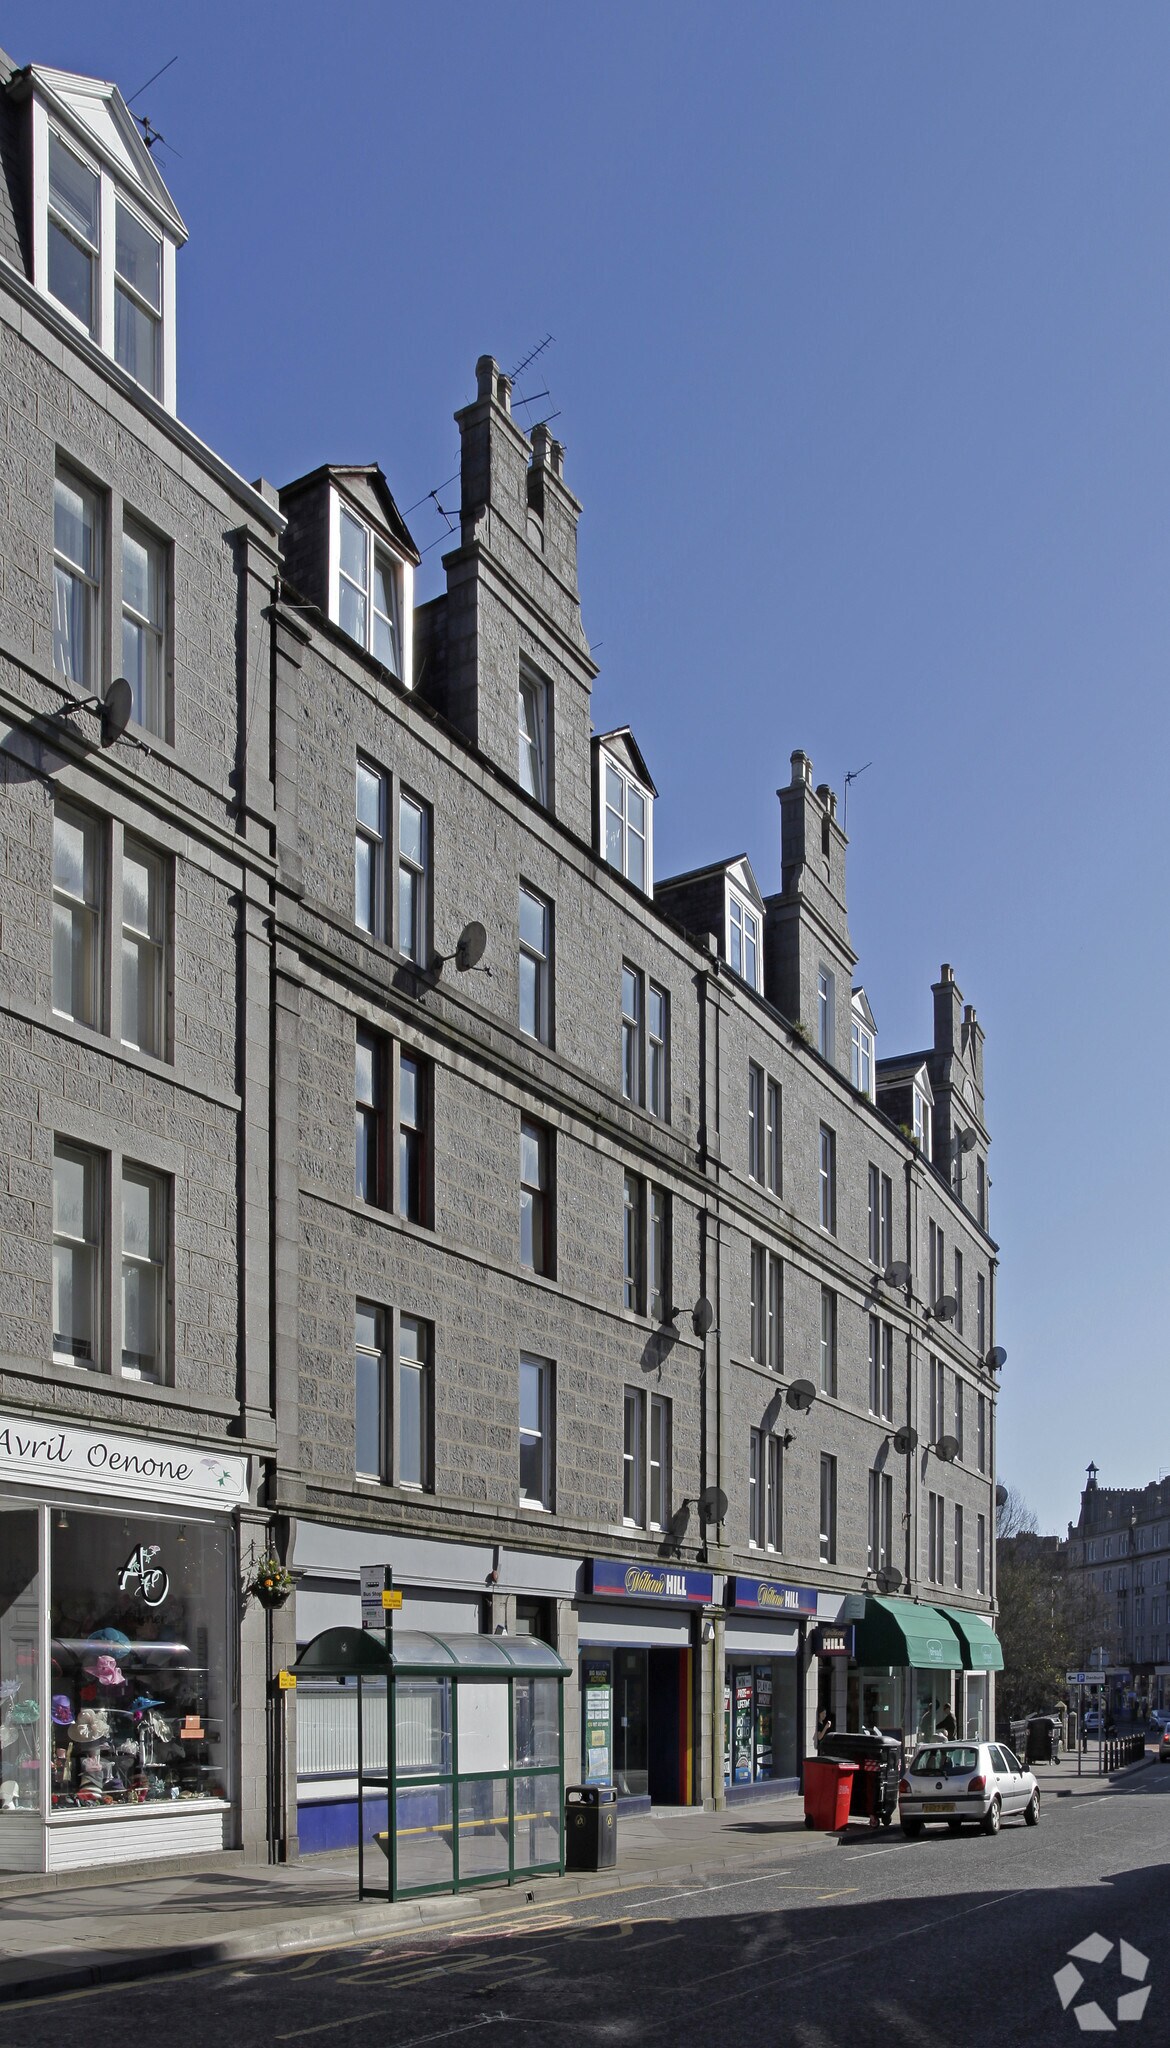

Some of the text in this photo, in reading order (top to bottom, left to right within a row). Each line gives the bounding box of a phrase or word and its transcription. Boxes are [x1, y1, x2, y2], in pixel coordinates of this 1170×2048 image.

[0, 1428, 193, 1481] Avril Oenone
[625, 1566, 687, 1596] William HILL
[757, 1583, 799, 1609] William HILL
[823, 1638, 846, 1650] HILL
